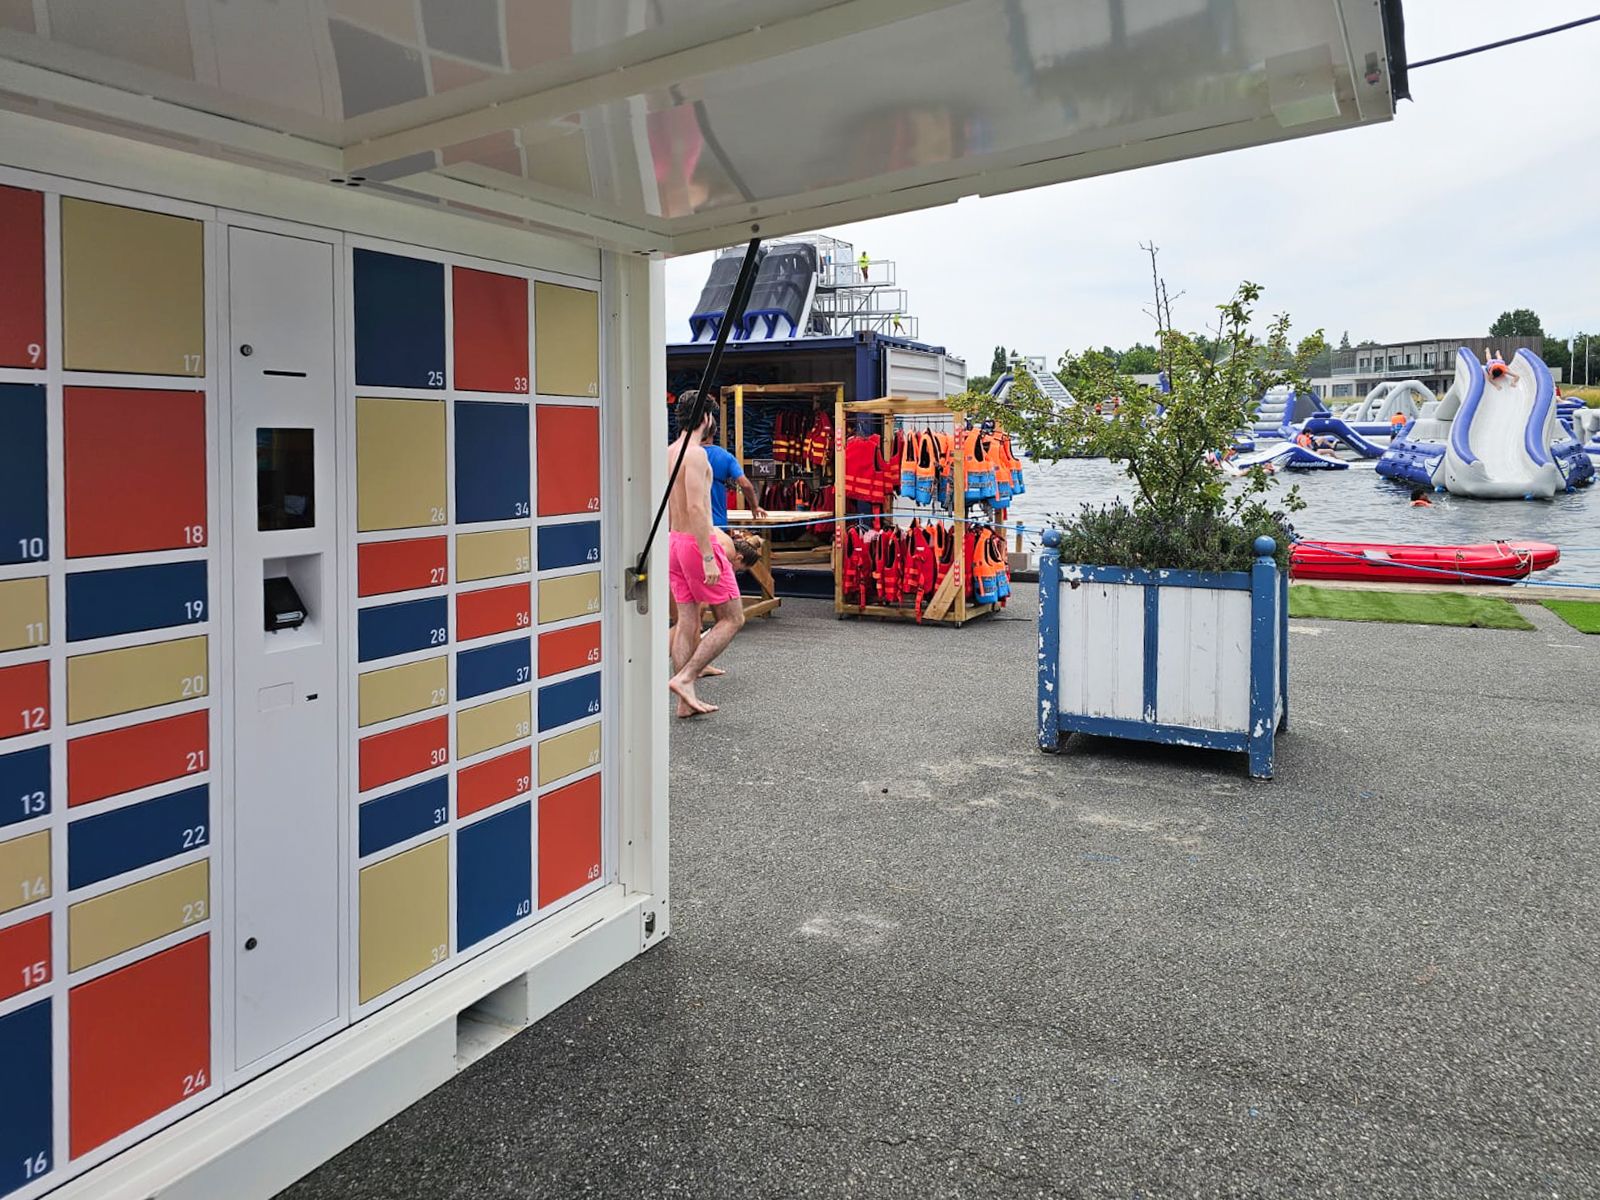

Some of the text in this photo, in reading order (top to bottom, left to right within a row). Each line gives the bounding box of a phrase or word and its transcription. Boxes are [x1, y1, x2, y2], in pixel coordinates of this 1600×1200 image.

[27, 344, 40, 362] 9
[184, 354, 202, 373] 17
[429, 372, 443, 385] 25
[514, 378, 527, 390] 33
[588, 382, 598, 394] 41
[759, 465, 770, 474] XL
[515, 503, 528, 515] 34
[587, 498, 598, 509] 42
[432, 507, 445, 522] 26
[185, 526, 203, 543] 18
[19, 538, 44, 558] 10
[586, 548, 598, 559] 43
[516, 557, 529, 570] 35
[431, 568, 444, 583] 27
[185, 601, 203, 619] 19
[587, 600, 598, 610] 44
[516, 612, 528, 625] 36
[26, 623, 43, 641] 11
[431, 628, 445, 643] 28
[587, 648, 598, 660] 45
[516, 667, 529, 681] 37
[183, 676, 204, 695] 20
[432, 689, 445, 703] 29
[587, 700, 599, 712] 46
[21, 708, 45, 729] 12
[516, 722, 528, 736] 38
[186, 750, 204, 771] 21
[431, 748, 445, 764] 30
[588, 751, 599, 763] 47
[517, 776, 529, 791] 39
[22, 792, 45, 814] 13
[434, 807, 446, 823] 31
[183, 826, 205, 848] 22
[587, 864, 599, 878] 48
[21, 878, 46, 901] 14
[183, 900, 206, 923] 23
[516, 900, 529, 915] 40
[432, 945, 446, 962] 32
[23, 962, 45, 986] 15
[184, 1071, 205, 1095] 24
[25, 1152, 46, 1178] 16
